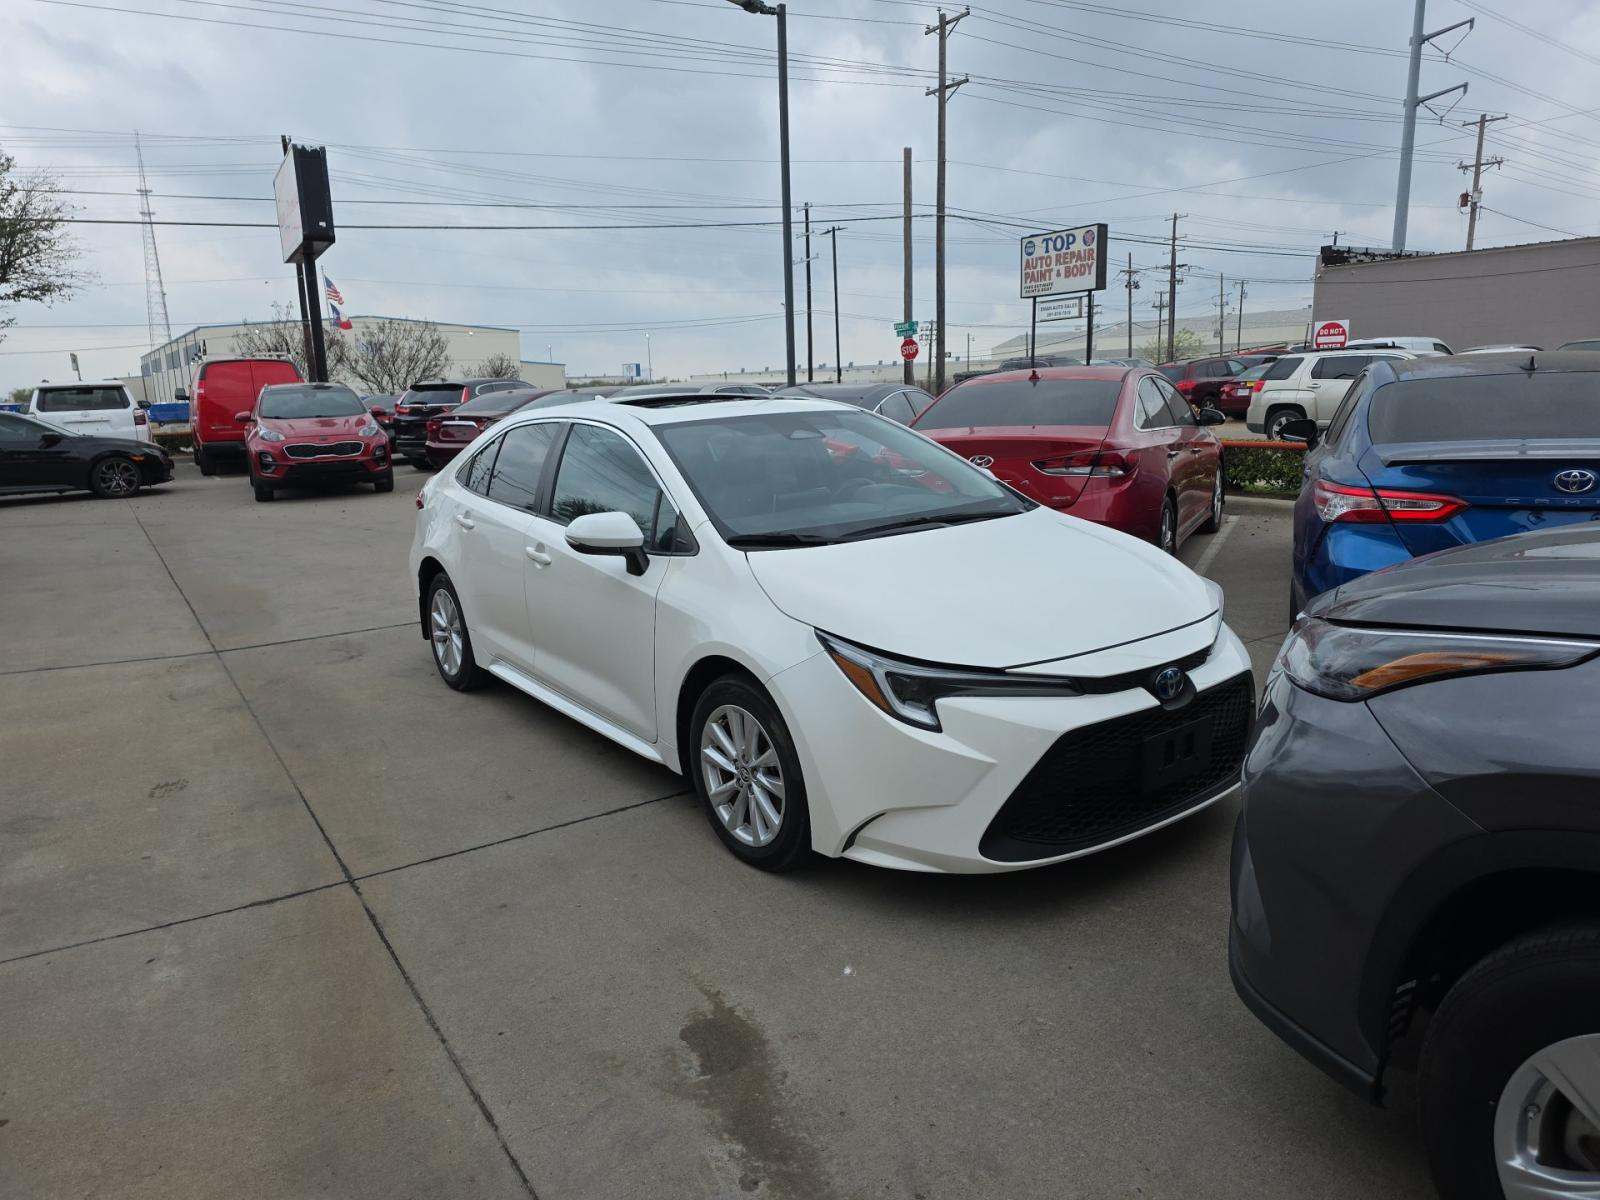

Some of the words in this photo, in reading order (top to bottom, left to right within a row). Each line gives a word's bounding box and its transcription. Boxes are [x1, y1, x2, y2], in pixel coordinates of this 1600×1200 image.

[1042, 233, 1076, 253] TOP
[1024, 255, 1052, 270] AUTO
[1055, 248, 1095, 266] REPAIR
[1024, 269, 1053, 284] PAINT
[1064, 262, 1094, 278] BODY
[902, 344, 917, 355] STOP
